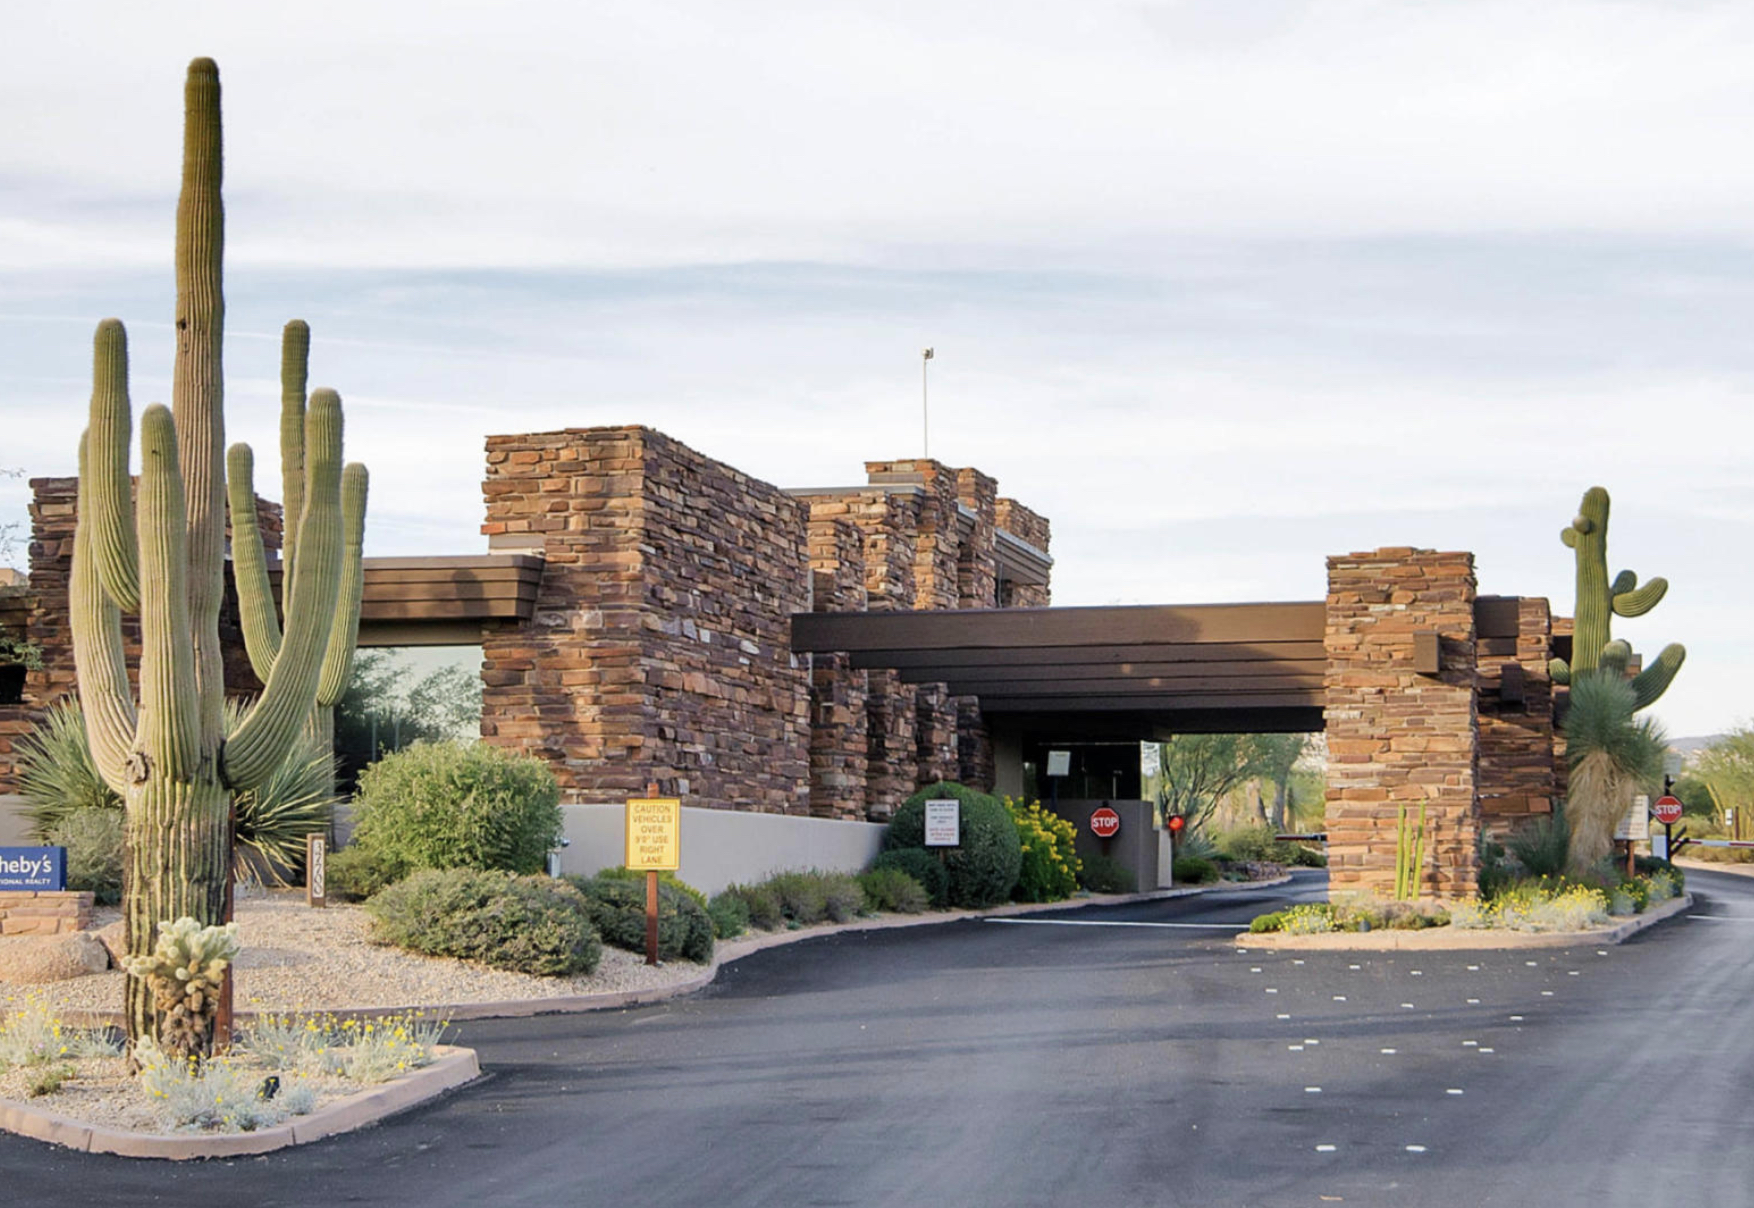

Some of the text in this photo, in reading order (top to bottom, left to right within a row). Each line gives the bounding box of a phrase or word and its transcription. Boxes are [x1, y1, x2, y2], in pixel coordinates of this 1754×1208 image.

[634, 804, 671, 813] CAUTION
[1657, 805, 1682, 814] STOP
[633, 814, 672, 823] VEHICLES
[1093, 817, 1118, 828] STOP
[640, 825, 664, 833] OVER
[652, 836, 669, 844] USE
[639, 846, 664, 854] RIGHT
[640, 856, 663, 865] LANE
